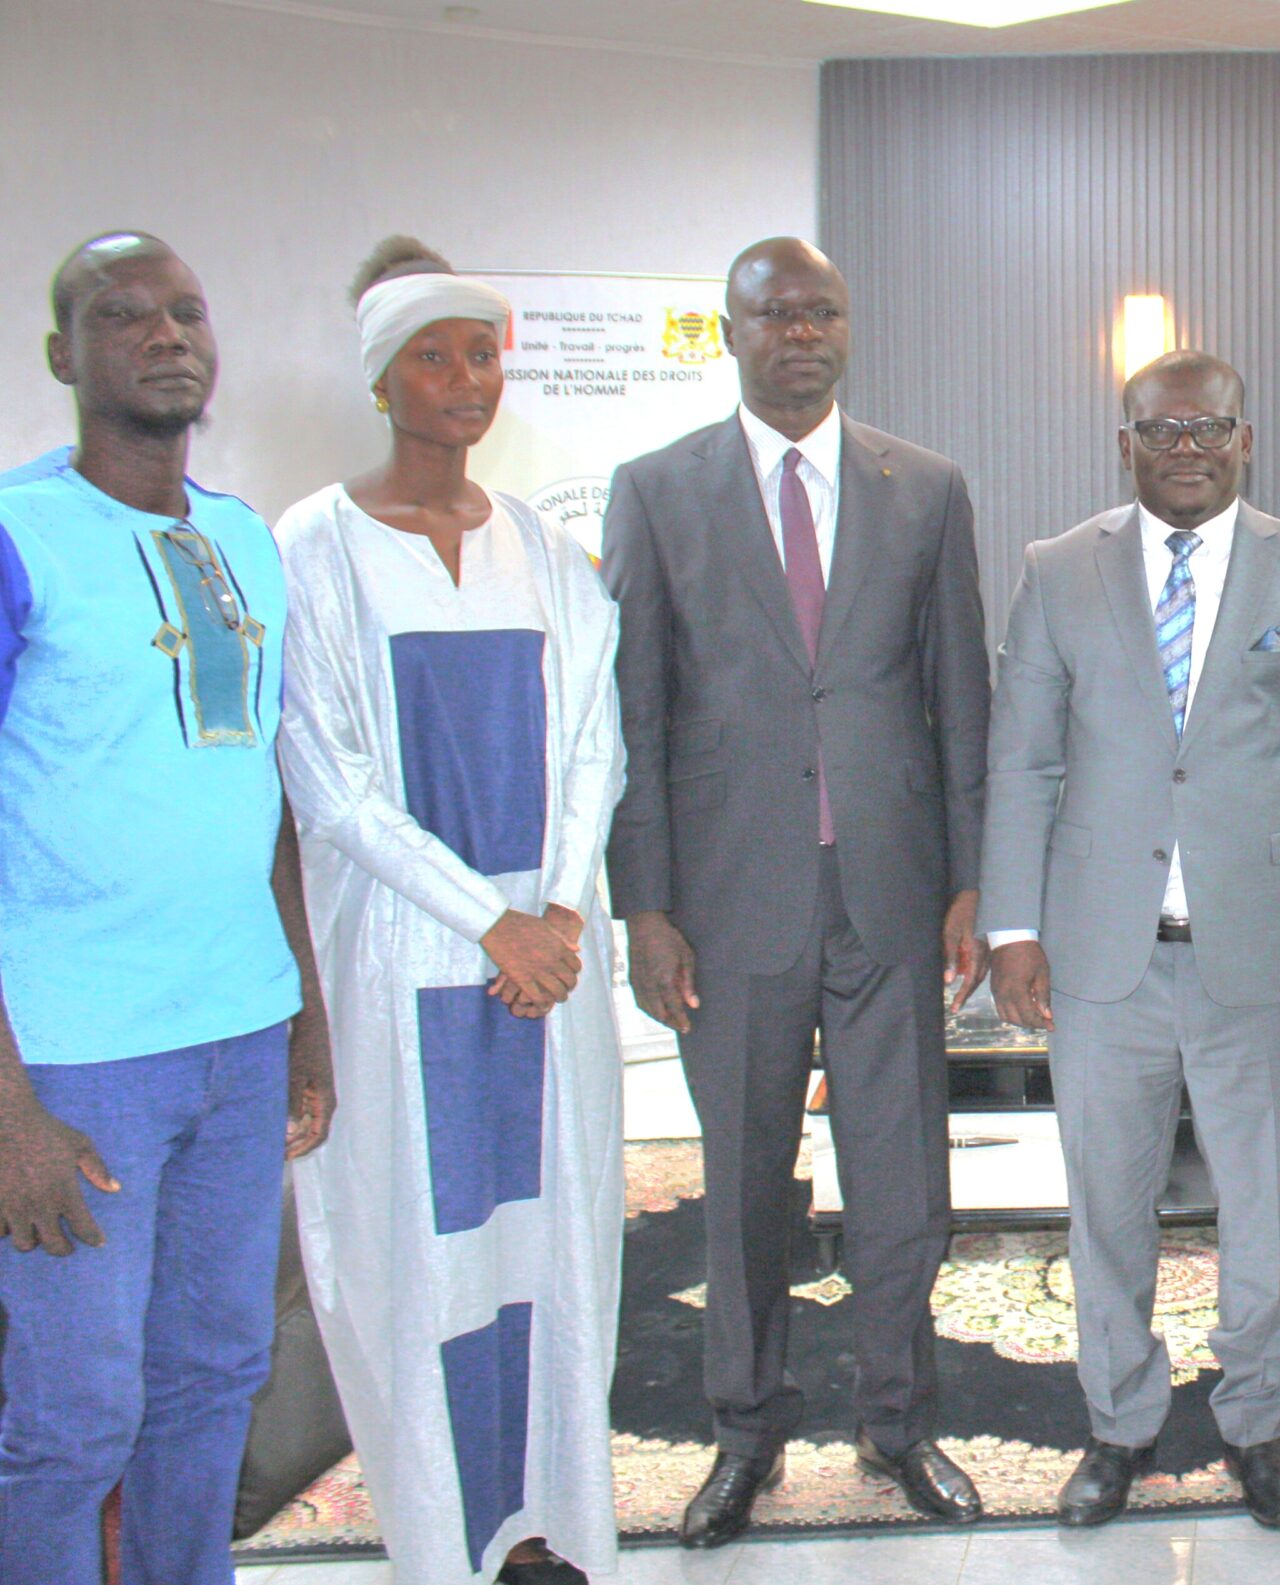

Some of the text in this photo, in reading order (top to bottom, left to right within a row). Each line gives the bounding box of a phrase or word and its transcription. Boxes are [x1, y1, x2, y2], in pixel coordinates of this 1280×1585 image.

[522, 311, 643, 323] REPUBLIQUE DU TCHAD
[559, 341, 594, 351] Travail
[605, 343, 645, 354] progrès
[504, 368, 703, 382] ISSION NATIONALE DES DROITS
[543, 384, 626, 396] DE L'HOMME
[536, 486, 588, 512] IONALE
[592, 486, 610, 501] DE
